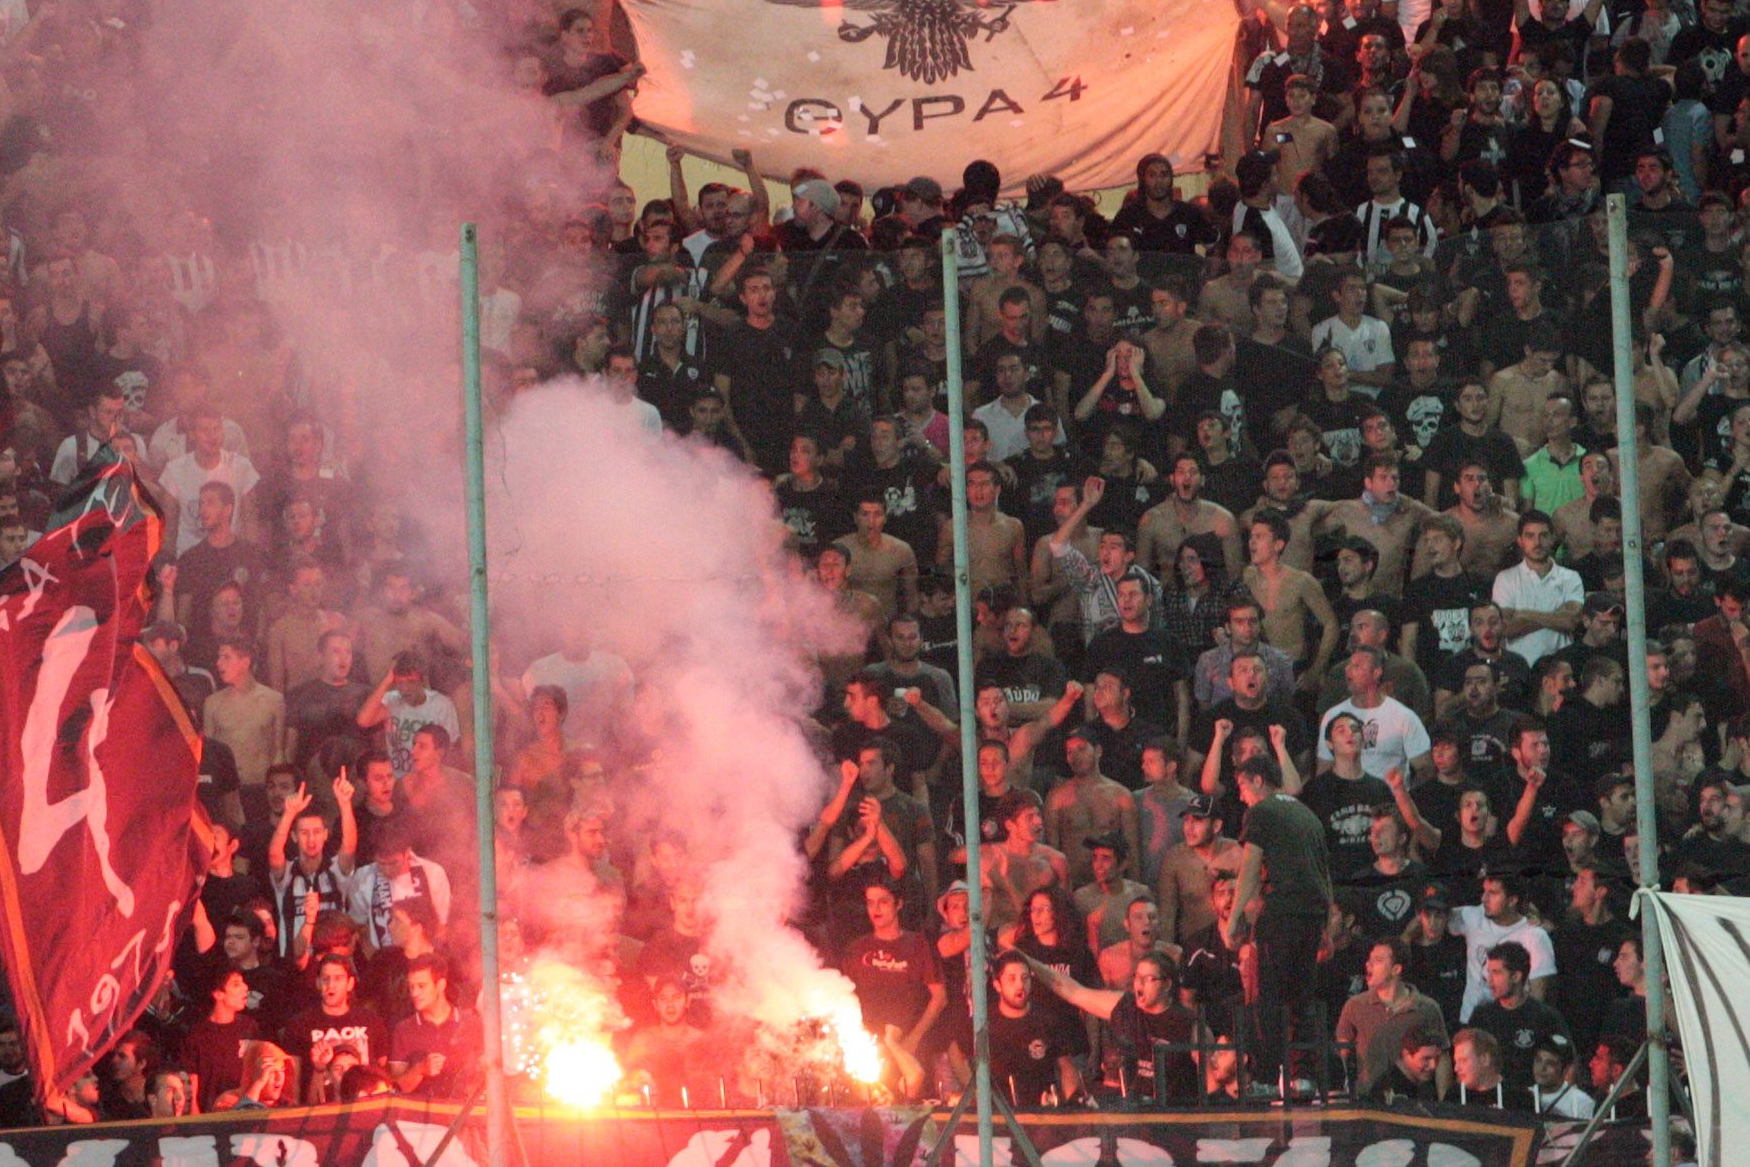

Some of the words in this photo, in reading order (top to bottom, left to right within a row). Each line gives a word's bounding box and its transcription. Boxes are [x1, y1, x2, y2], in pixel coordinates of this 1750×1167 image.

[784, 88, 1026, 137] ΘΥΡΑ
[1040, 75, 1090, 104] 4
[17, 604, 135, 920] 4
[310, 1027, 369, 1043] PAOK
